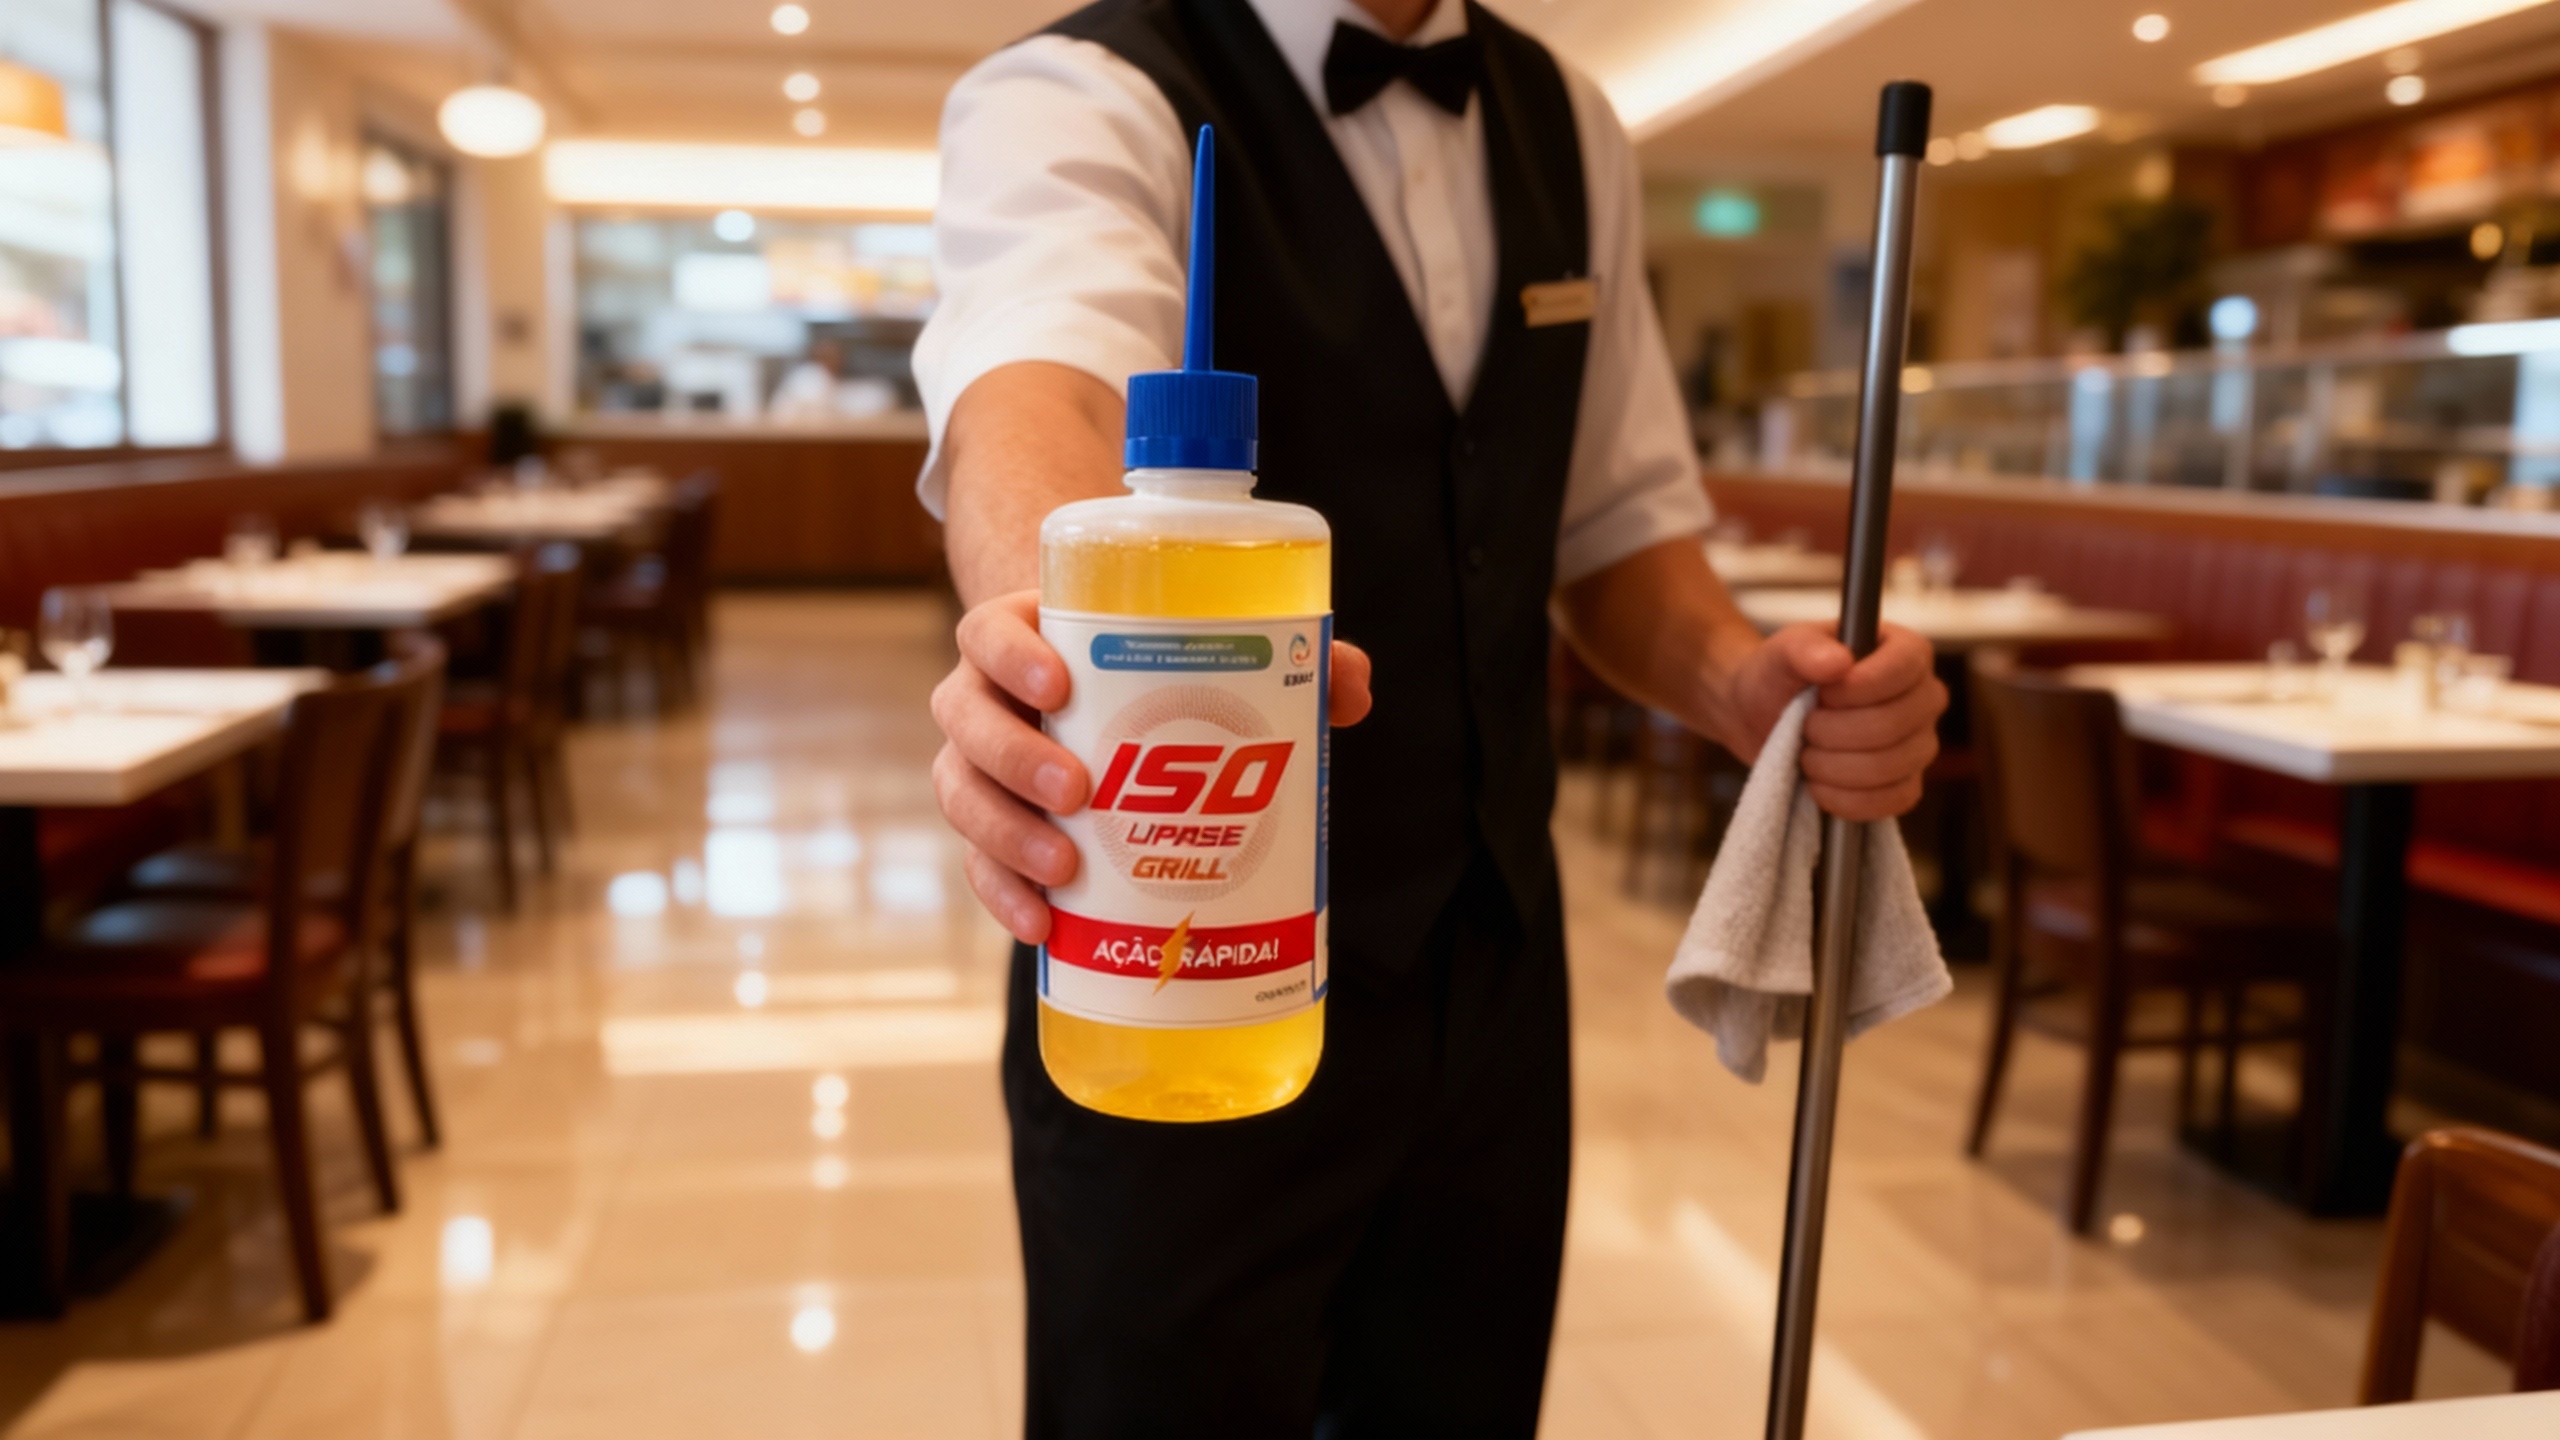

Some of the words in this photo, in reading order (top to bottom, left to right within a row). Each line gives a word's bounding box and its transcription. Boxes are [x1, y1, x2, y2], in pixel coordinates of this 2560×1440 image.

[1089, 741, 1295, 815] ISO
[1132, 856, 1228, 880] GRILL
[1180, 937, 1280, 968] RÁPIDA!
